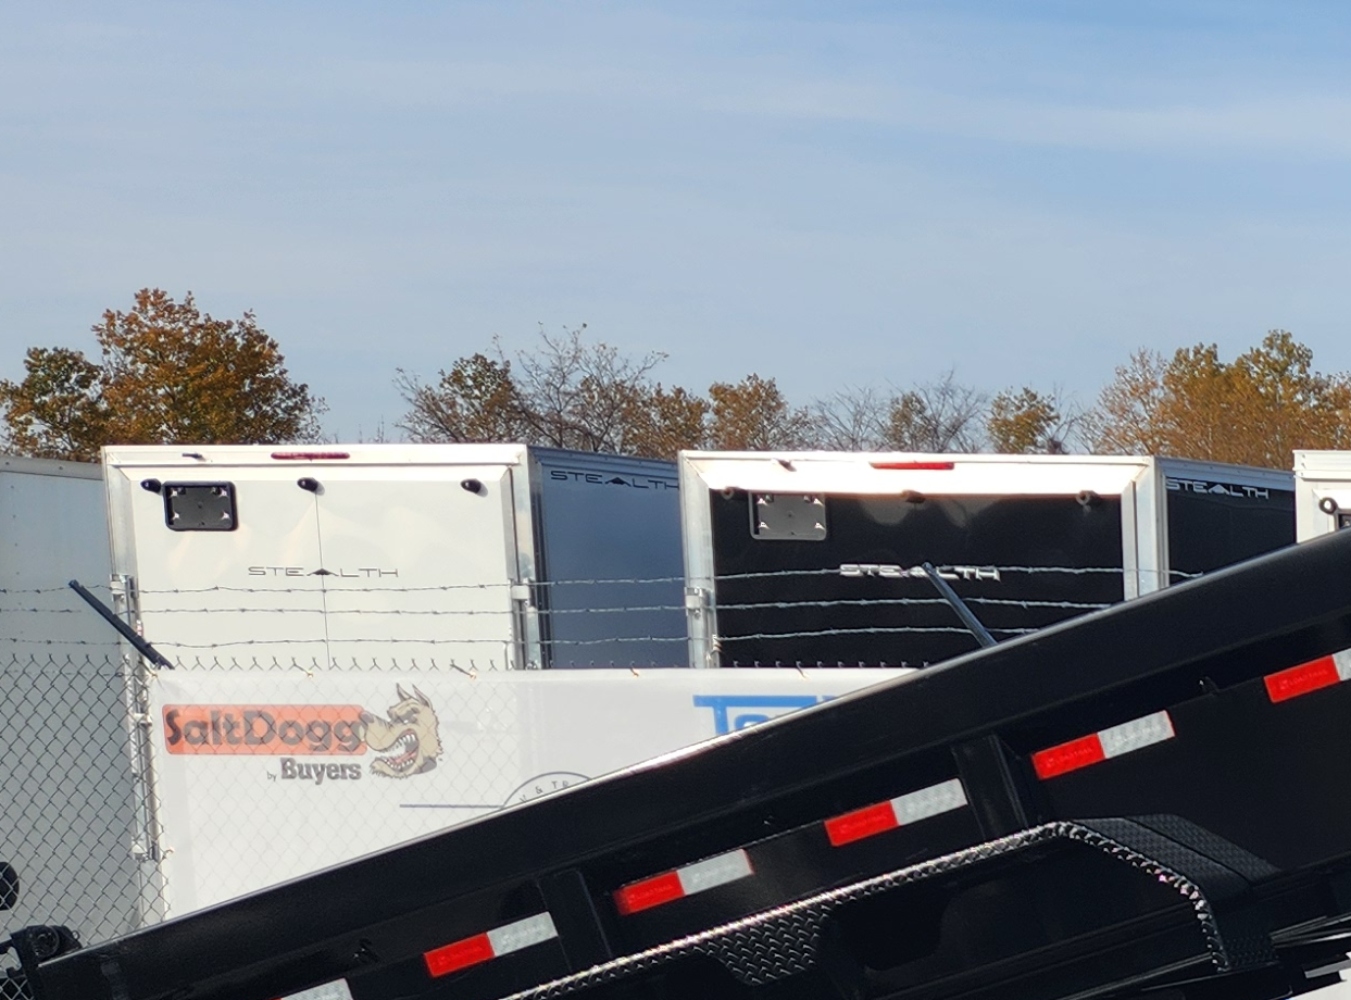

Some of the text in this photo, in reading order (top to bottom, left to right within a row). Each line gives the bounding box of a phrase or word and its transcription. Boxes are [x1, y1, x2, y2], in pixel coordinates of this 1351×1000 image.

[165, 709, 364, 754] SaltDogg
[267, 757, 362, 786] by Buyers
